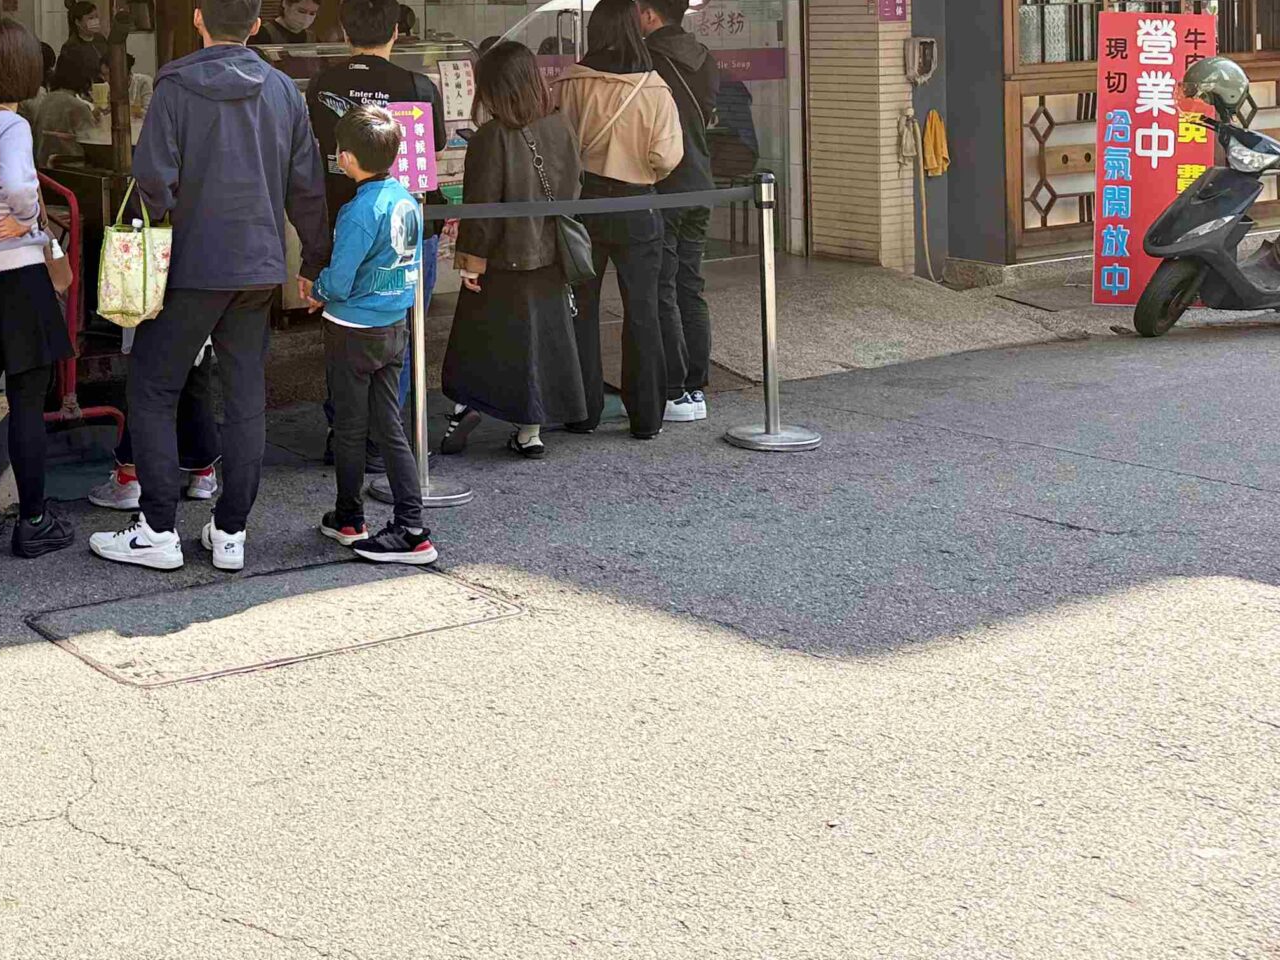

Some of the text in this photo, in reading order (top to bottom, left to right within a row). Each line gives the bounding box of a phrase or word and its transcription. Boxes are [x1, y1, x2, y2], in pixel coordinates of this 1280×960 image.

[349, 89, 390, 100] Enter the
[1105, 37, 1128, 94] 現切
[1134, 18, 1177, 170] 營業中
[1101, 109, 1132, 296] 冷氣開放中
